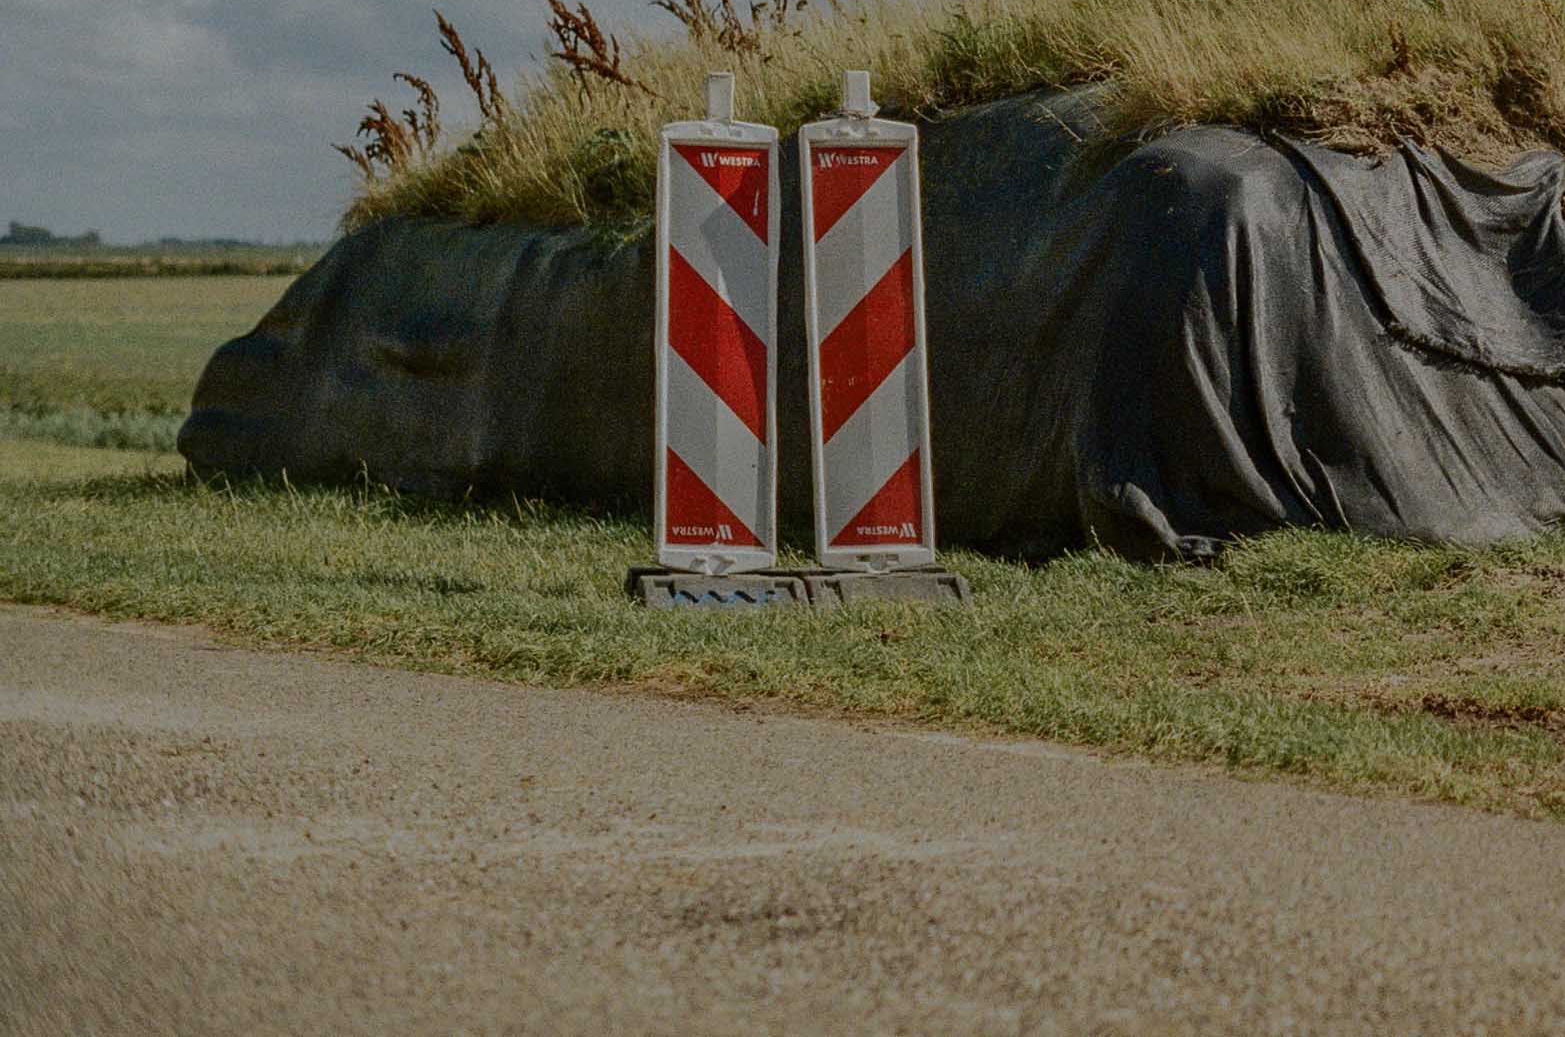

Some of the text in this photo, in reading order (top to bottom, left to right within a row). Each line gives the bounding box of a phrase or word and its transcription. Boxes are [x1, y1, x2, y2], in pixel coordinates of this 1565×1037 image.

[719, 155, 760, 167] WESTRA
[672, 525, 715, 537] WESTRA
[856, 524, 899, 536] WESTRA
